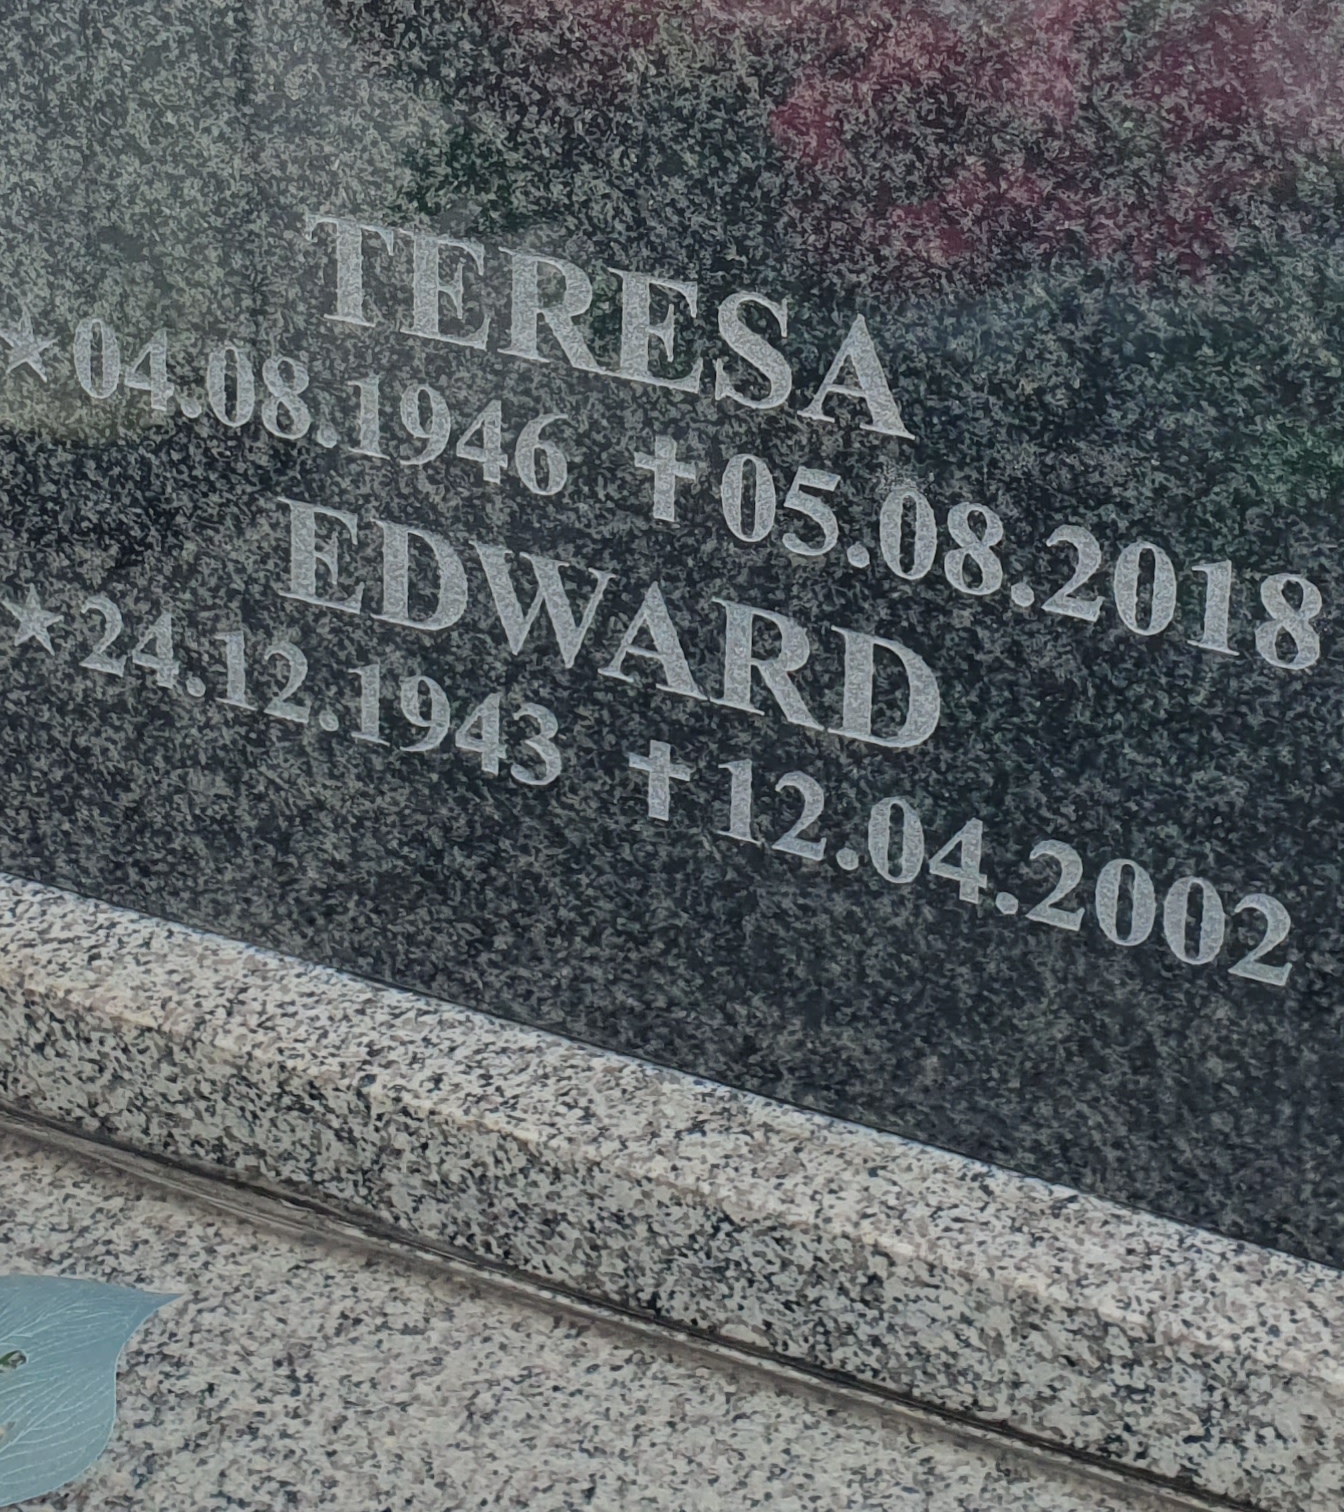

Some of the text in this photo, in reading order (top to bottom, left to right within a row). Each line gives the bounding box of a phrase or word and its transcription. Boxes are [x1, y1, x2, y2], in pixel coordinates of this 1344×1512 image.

[308, 215, 916, 441] TERESA
[74, 318, 1324, 671] 04.08.1946 05.08.2018
[278, 500, 942, 750] EDWARD
[80, 598, 1294, 987] 24.12.1943 12.04.2002
